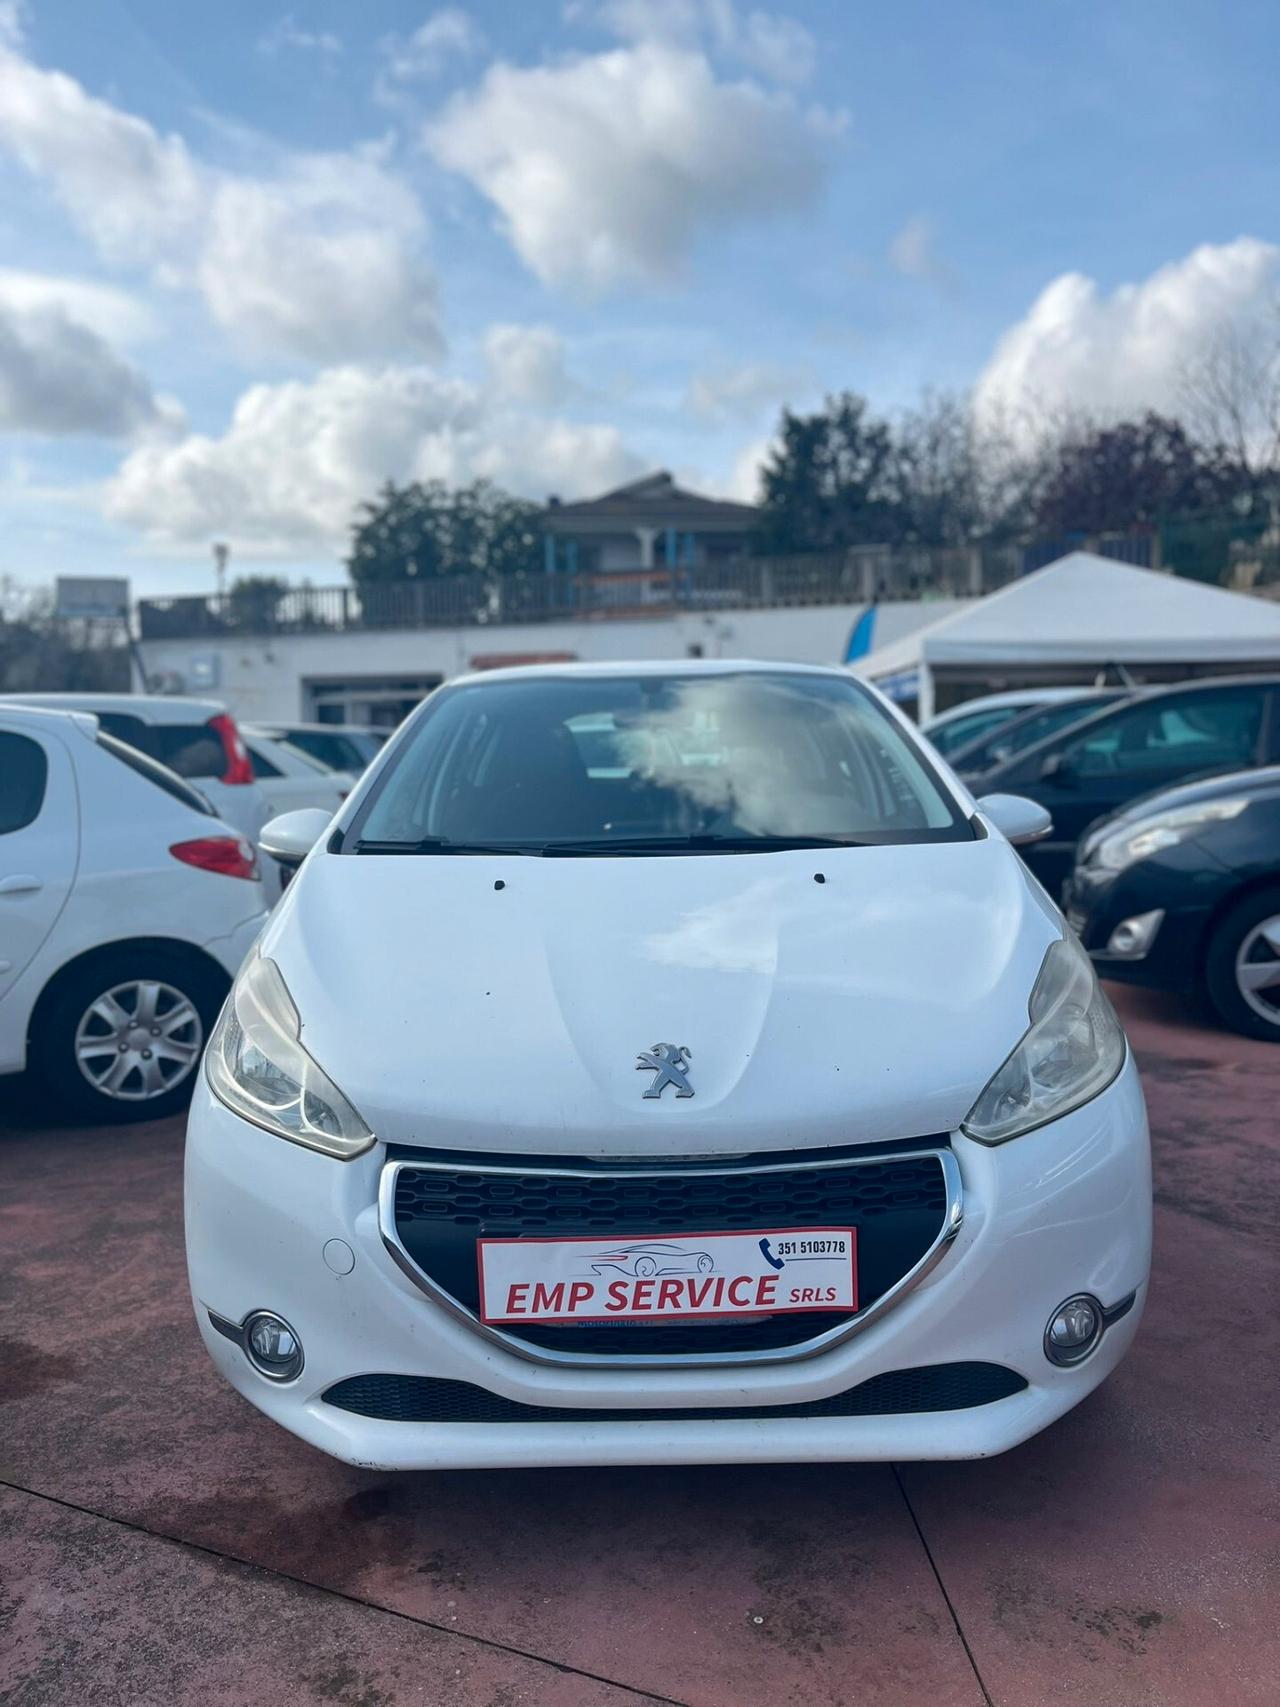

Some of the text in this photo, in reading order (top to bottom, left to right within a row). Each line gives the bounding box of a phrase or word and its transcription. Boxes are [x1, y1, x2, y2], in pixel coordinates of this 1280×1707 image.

[778, 1240, 845, 1255] 351 5103778
[506, 1275, 837, 1314] EMP SERVICE SRLS
